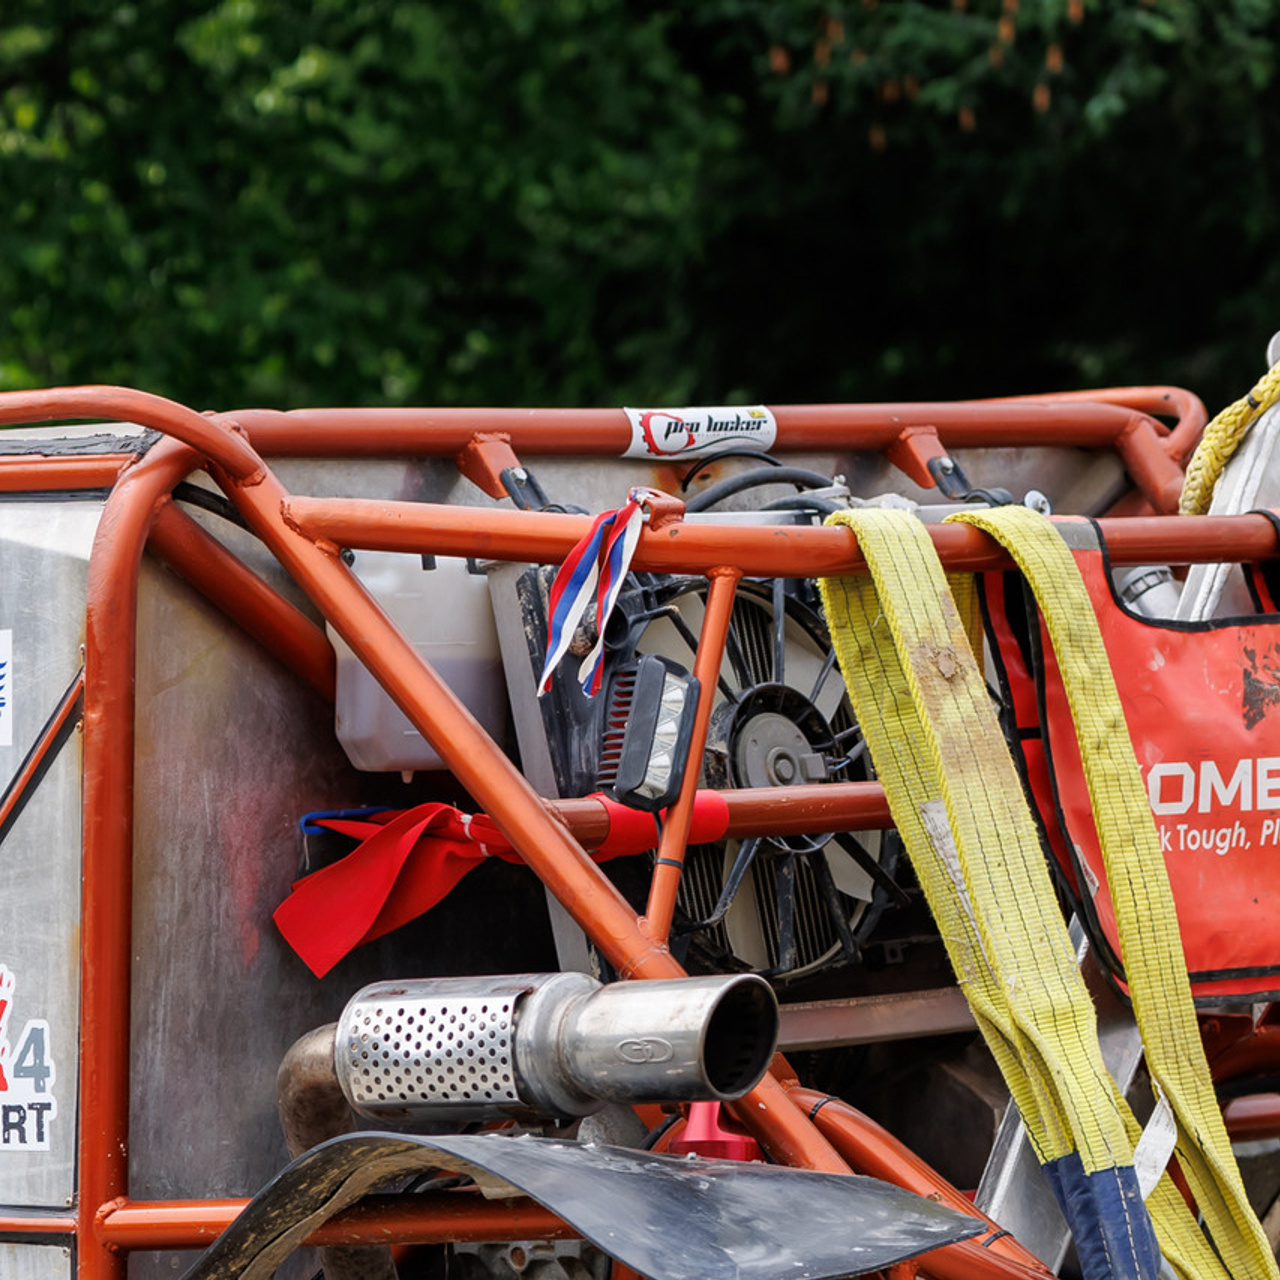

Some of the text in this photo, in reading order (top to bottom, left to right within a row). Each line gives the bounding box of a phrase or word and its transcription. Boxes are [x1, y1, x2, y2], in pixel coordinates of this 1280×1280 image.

[706, 414, 768, 433] locker
[1138, 757, 1280, 816] OME
[1176, 820, 1252, 856] Tough,
